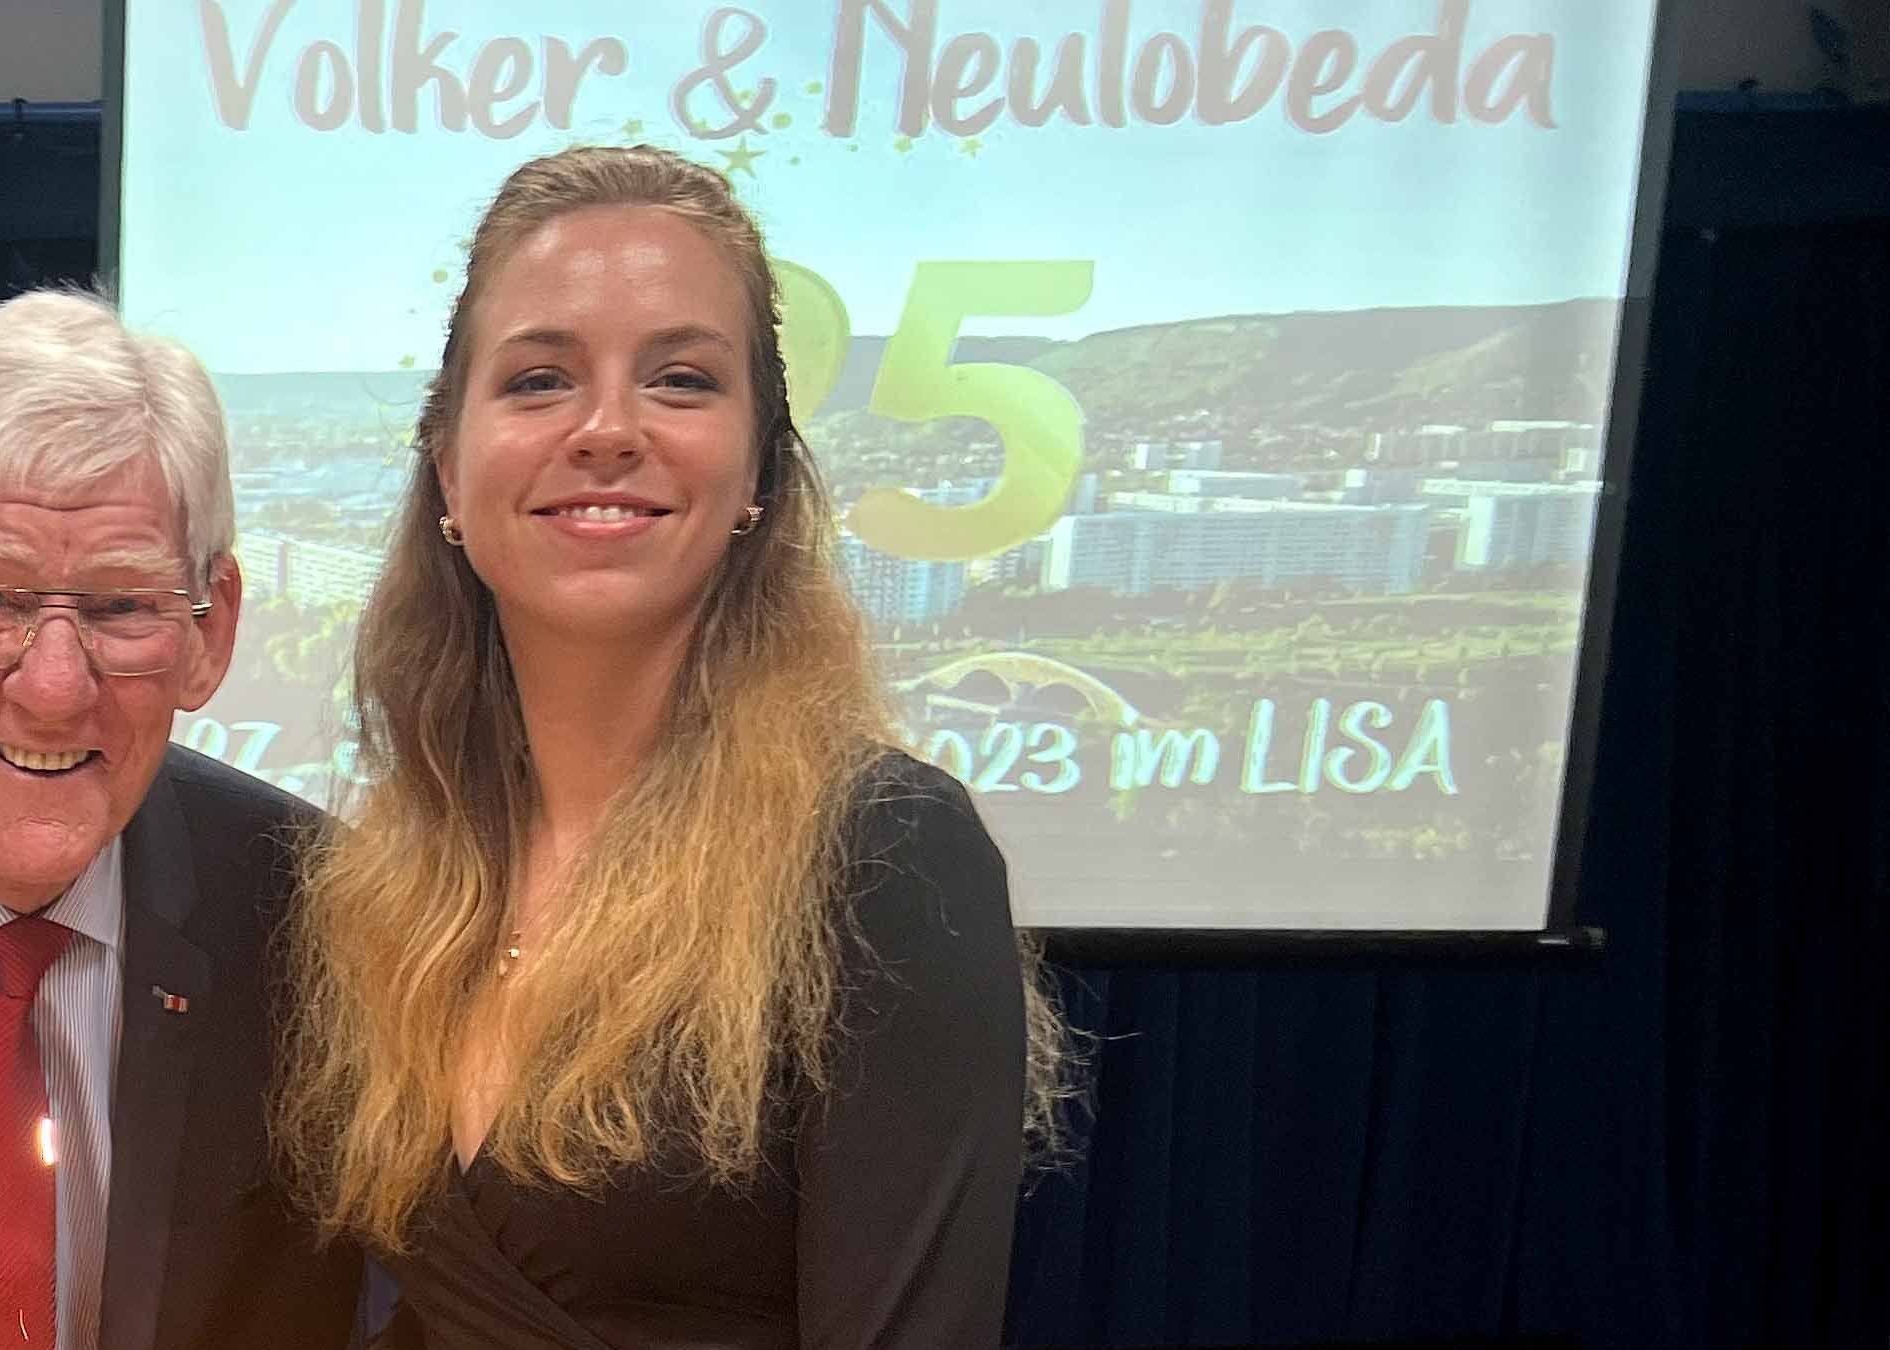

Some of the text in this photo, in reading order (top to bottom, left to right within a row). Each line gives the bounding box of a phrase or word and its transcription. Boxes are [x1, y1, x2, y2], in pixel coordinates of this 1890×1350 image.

[198, 0, 1559, 139] Volker & Neulobeda
[1110, 726, 1221, 791] im
[1240, 698, 1460, 796] LISA
